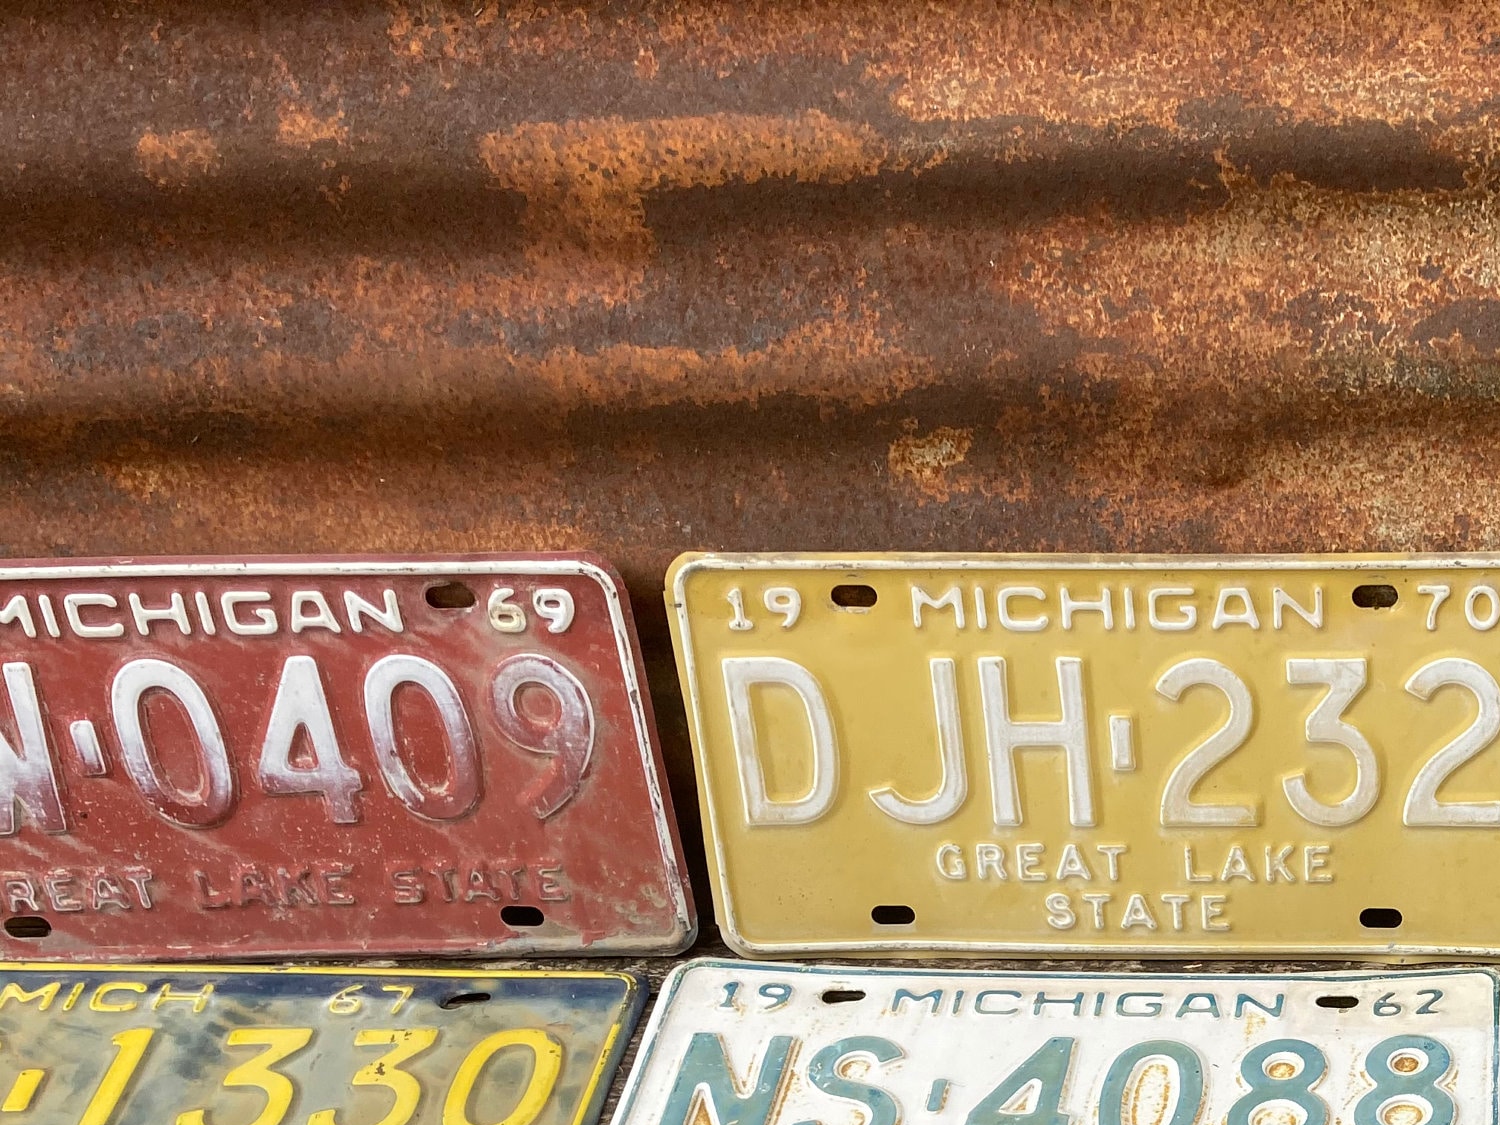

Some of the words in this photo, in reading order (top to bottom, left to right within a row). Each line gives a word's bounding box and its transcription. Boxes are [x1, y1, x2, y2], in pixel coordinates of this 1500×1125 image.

[487, 587, 575, 633] 69
[728, 585, 801, 631] 19
[911, 584, 1325, 631] MICHIGAN
[1417, 583, 1500, 632] 70
[198, 862, 355, 908] LAKE
[394, 856, 571, 904] STATE
[935, 842, 1129, 883] GREAT
[1184, 844, 1335, 884] LAKE
[1044, 893, 1232, 932] STATE
[0, 981, 215, 1014] MICH
[328, 984, 415, 1014] 67
[721, 980, 793, 1011] 19
[891, 988, 1285, 1018] MICHIGAN
[1373, 989, 1442, 1018] 62
